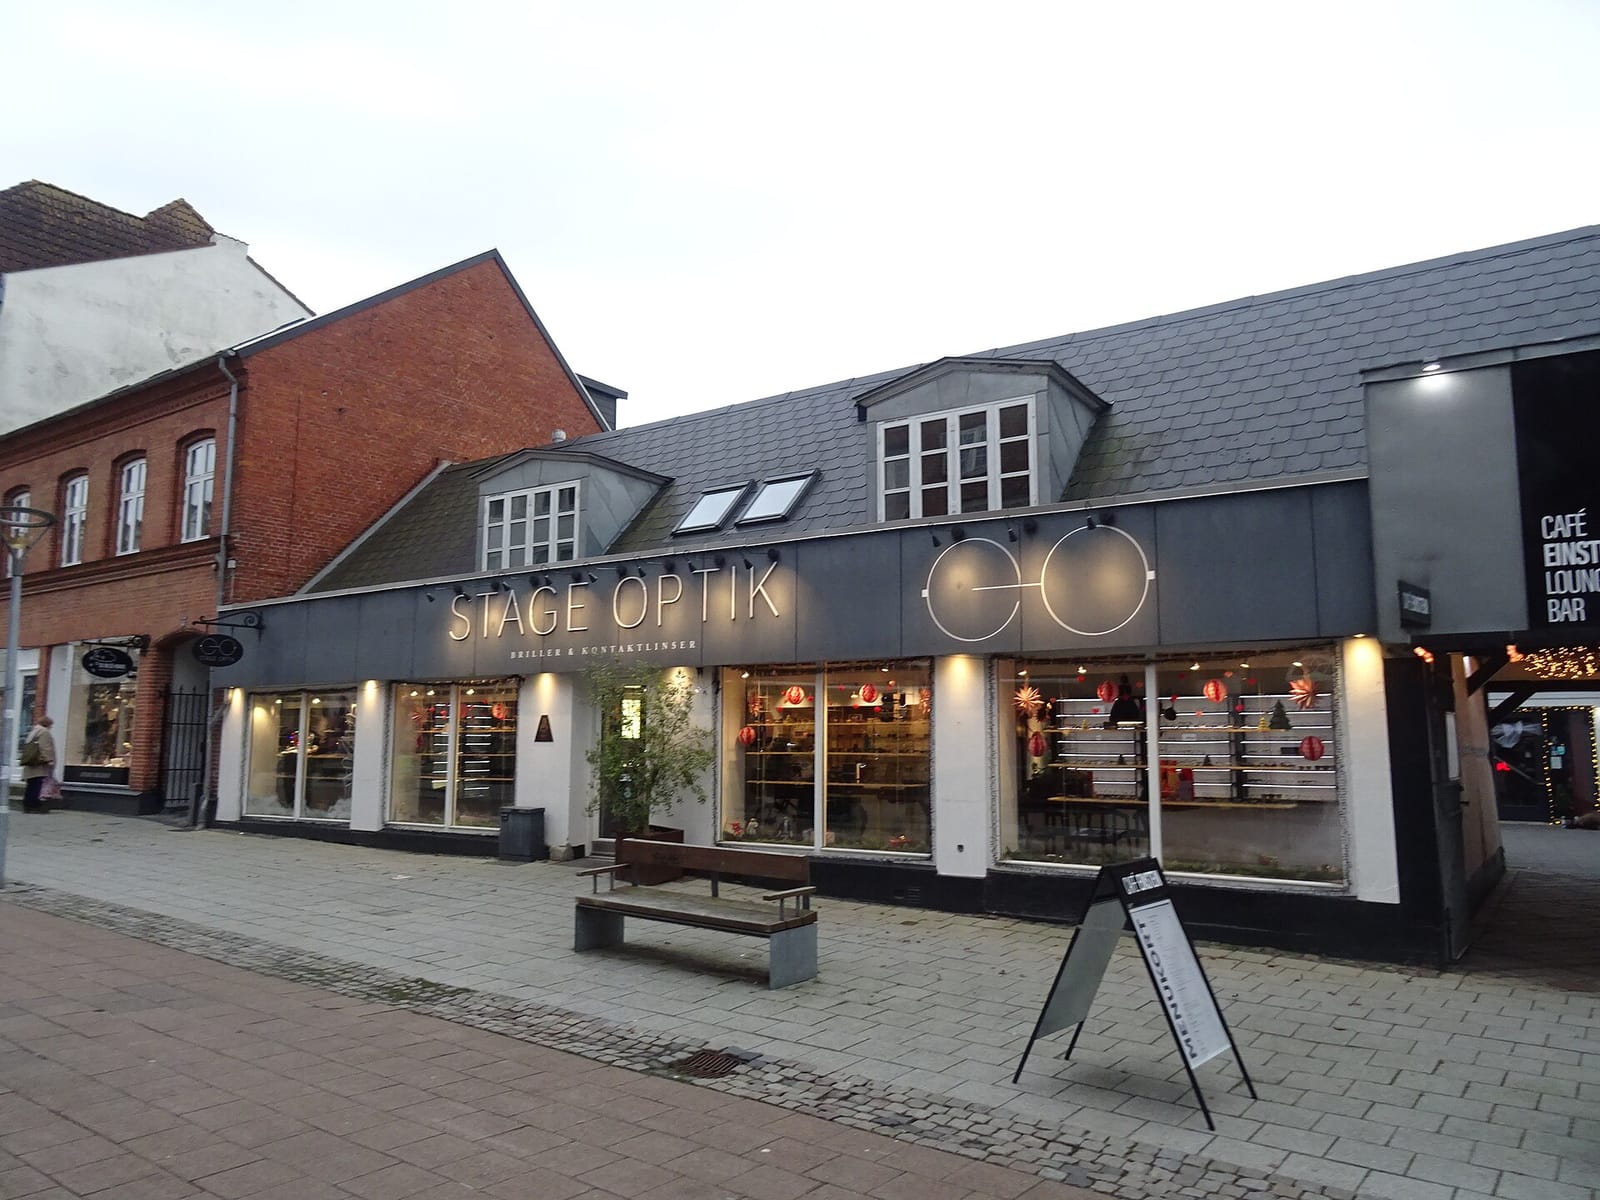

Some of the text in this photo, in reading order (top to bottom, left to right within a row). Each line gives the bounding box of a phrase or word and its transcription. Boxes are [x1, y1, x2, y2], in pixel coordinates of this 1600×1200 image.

[1541, 508, 1587, 539] CAFÉ
[449, 561, 780, 641] STAGE OPTIK
[1547, 597, 1586, 623] BAR
[510, 640, 697, 659] BRILLER & KONTAKTLINSER
[1136, 918, 1198, 1059] MENUKORT
